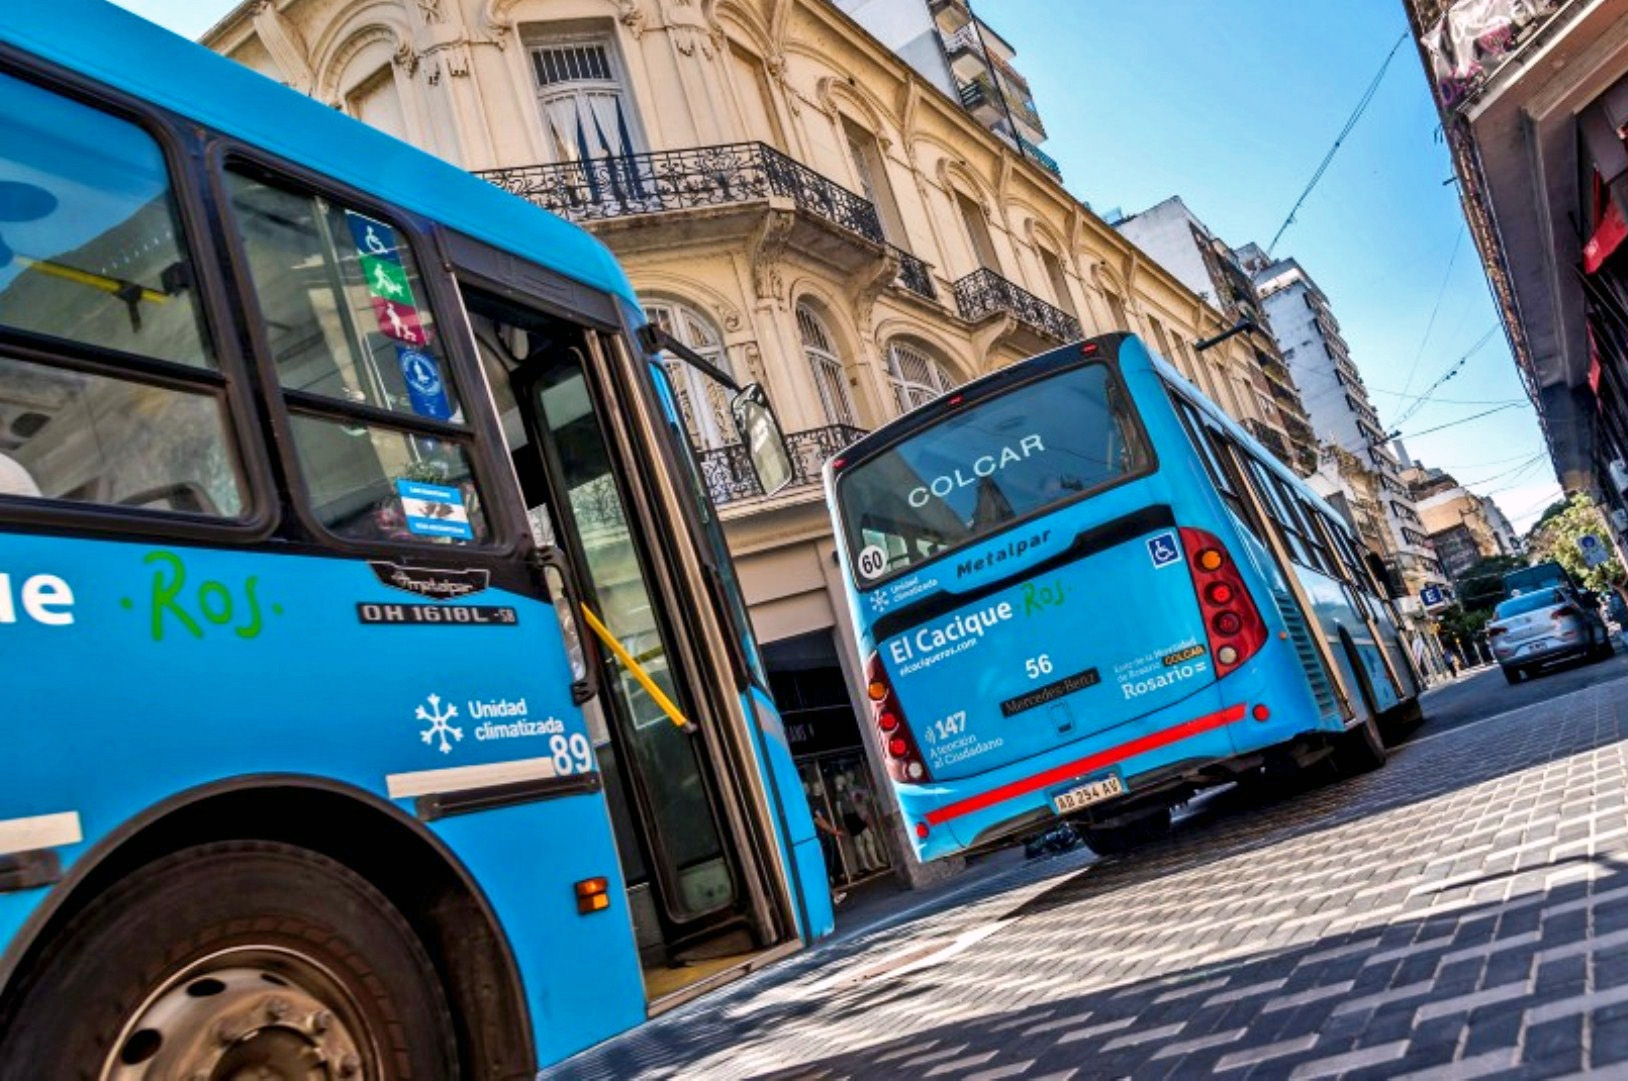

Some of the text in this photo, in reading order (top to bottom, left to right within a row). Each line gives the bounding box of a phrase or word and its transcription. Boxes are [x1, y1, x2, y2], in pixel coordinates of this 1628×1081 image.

[908, 434, 1045, 507] COLCAR
[862, 550, 883, 574] 60
[956, 528, 1051, 578] Metalpar
[362, 604, 404, 621] OH
[890, 638, 912, 665] El
[915, 601, 1013, 655] Cacique
[1026, 653, 1054, 680] 56
[1004, 673, 1095, 714] Mercedes-Benz
[1121, 664, 1193, 700] Rosario
[468, 698, 527, 719] Unidad
[475, 716, 564, 741] climatizada
[935, 710, 966, 740] 147
[549, 733, 592, 776] 89
[945, 738, 1003, 764] Ciudadano
[1102, 778, 1119, 796] AV
